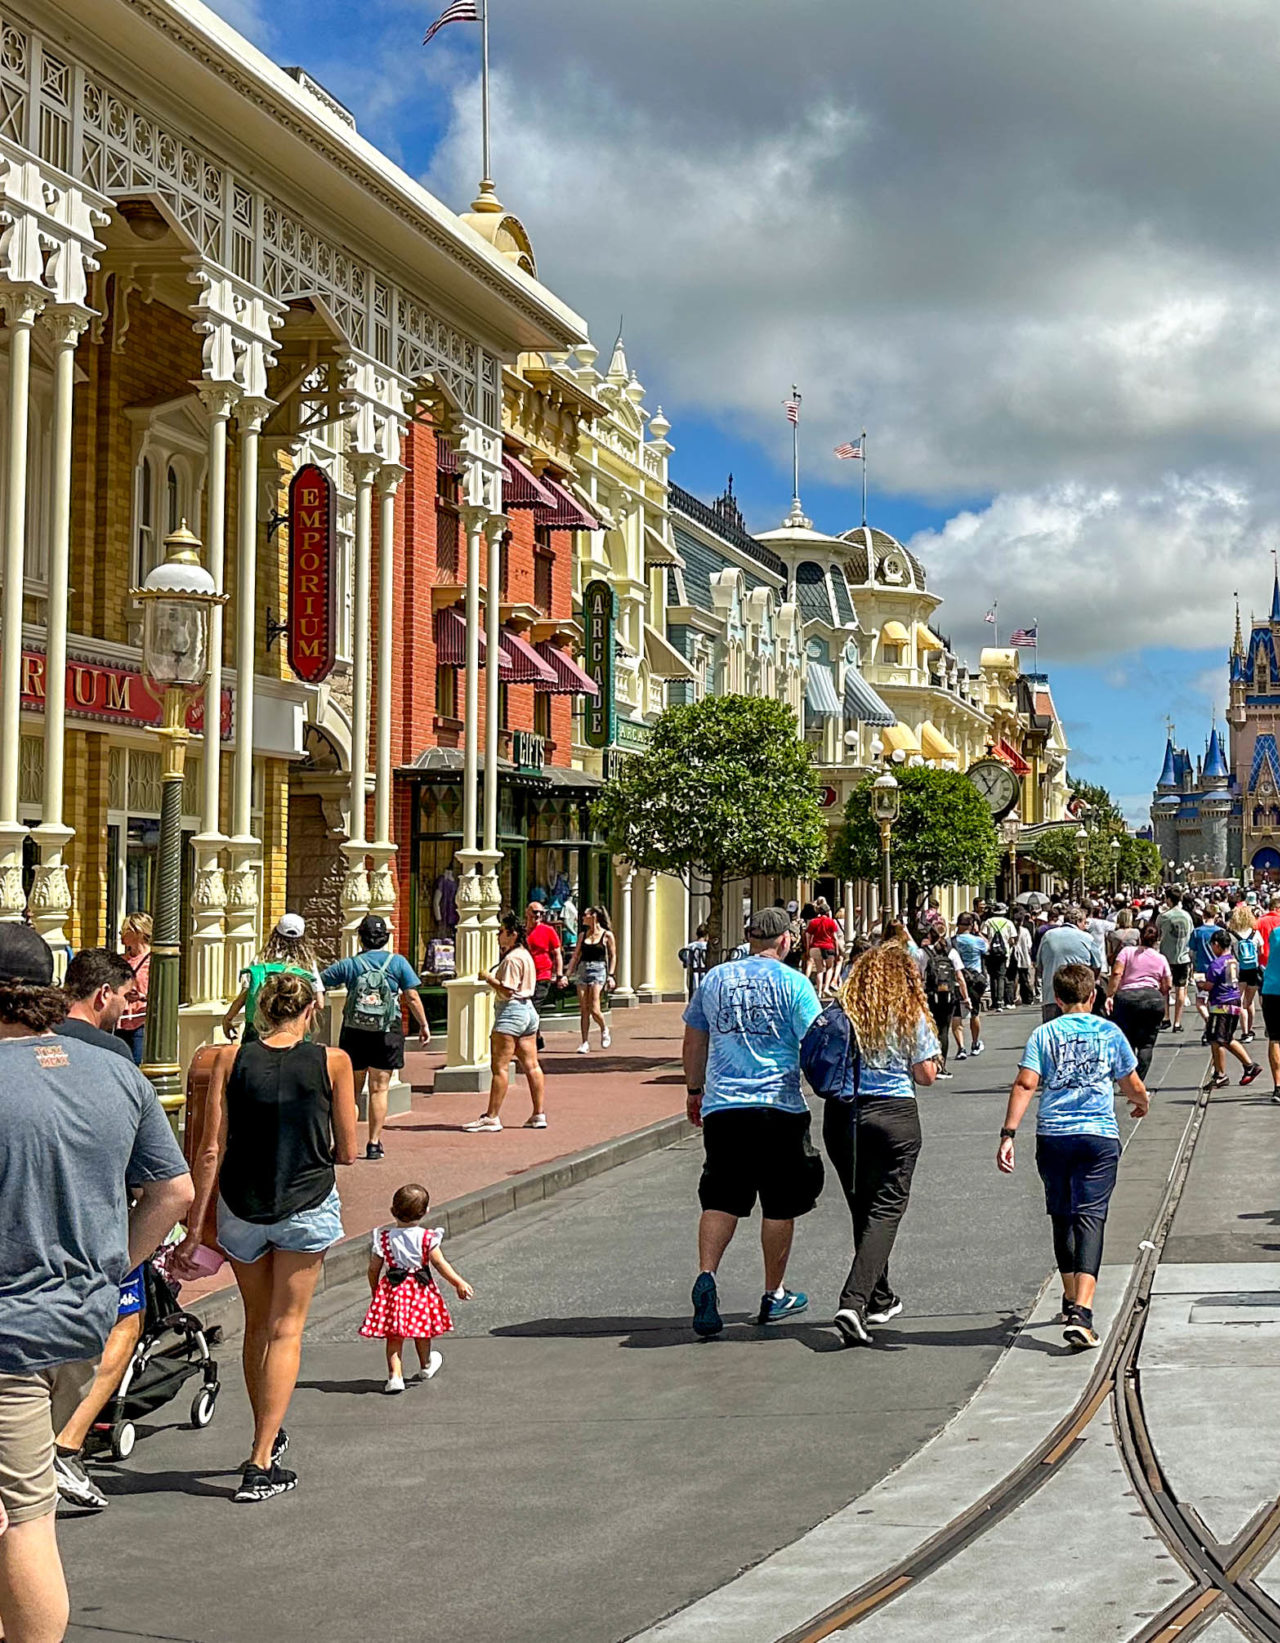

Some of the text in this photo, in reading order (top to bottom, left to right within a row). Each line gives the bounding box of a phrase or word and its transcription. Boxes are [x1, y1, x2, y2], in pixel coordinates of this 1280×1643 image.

[298, 488, 323, 657] EMPORIUM
[21, 656, 134, 712] RUM
[592, 595, 604, 733] ARCADE
[519, 732, 545, 768] GIFTS
